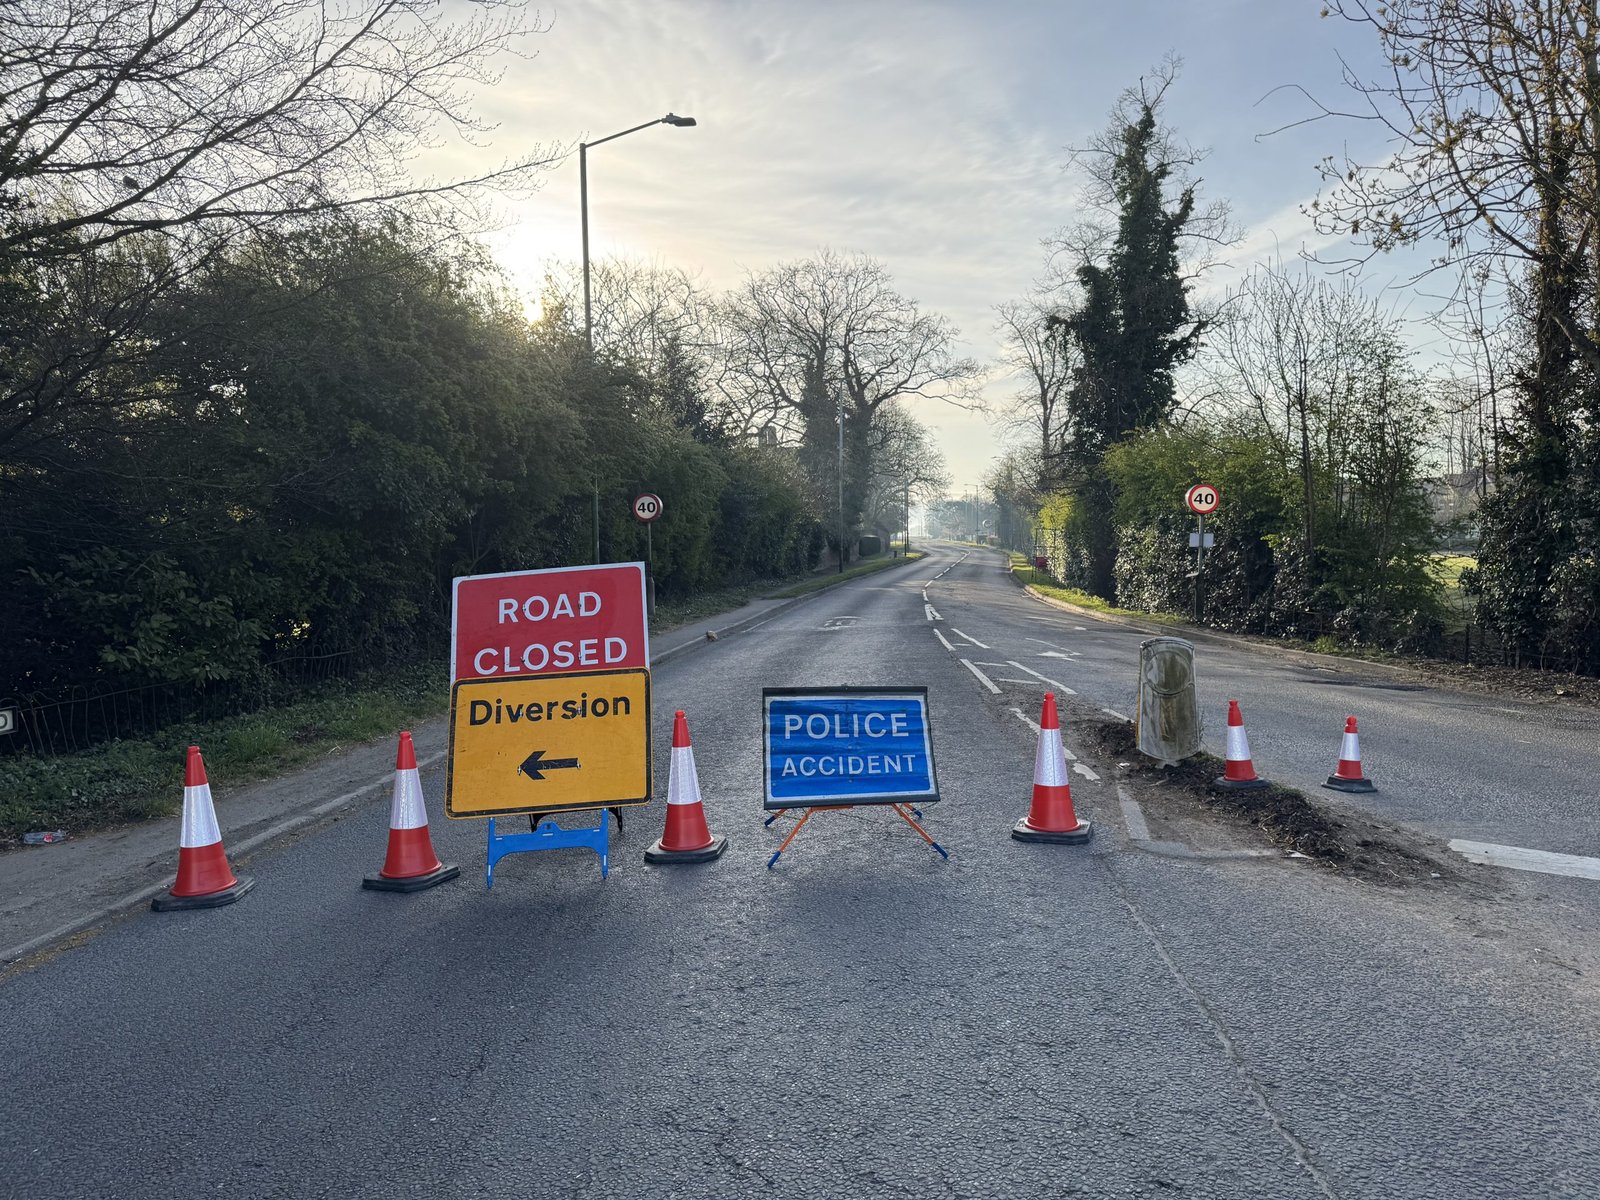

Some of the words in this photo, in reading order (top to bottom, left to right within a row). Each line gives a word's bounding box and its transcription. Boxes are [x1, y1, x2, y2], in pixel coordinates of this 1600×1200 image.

[637, 502, 656, 513] 40
[1193, 493, 1215, 505] 40
[498, 591, 602, 624] ROAD
[474, 637, 628, 675] CLOSED
[469, 692, 631, 726] Diversion
[784, 712, 910, 740] POLICE
[781, 754, 916, 777] ACCIDENT
